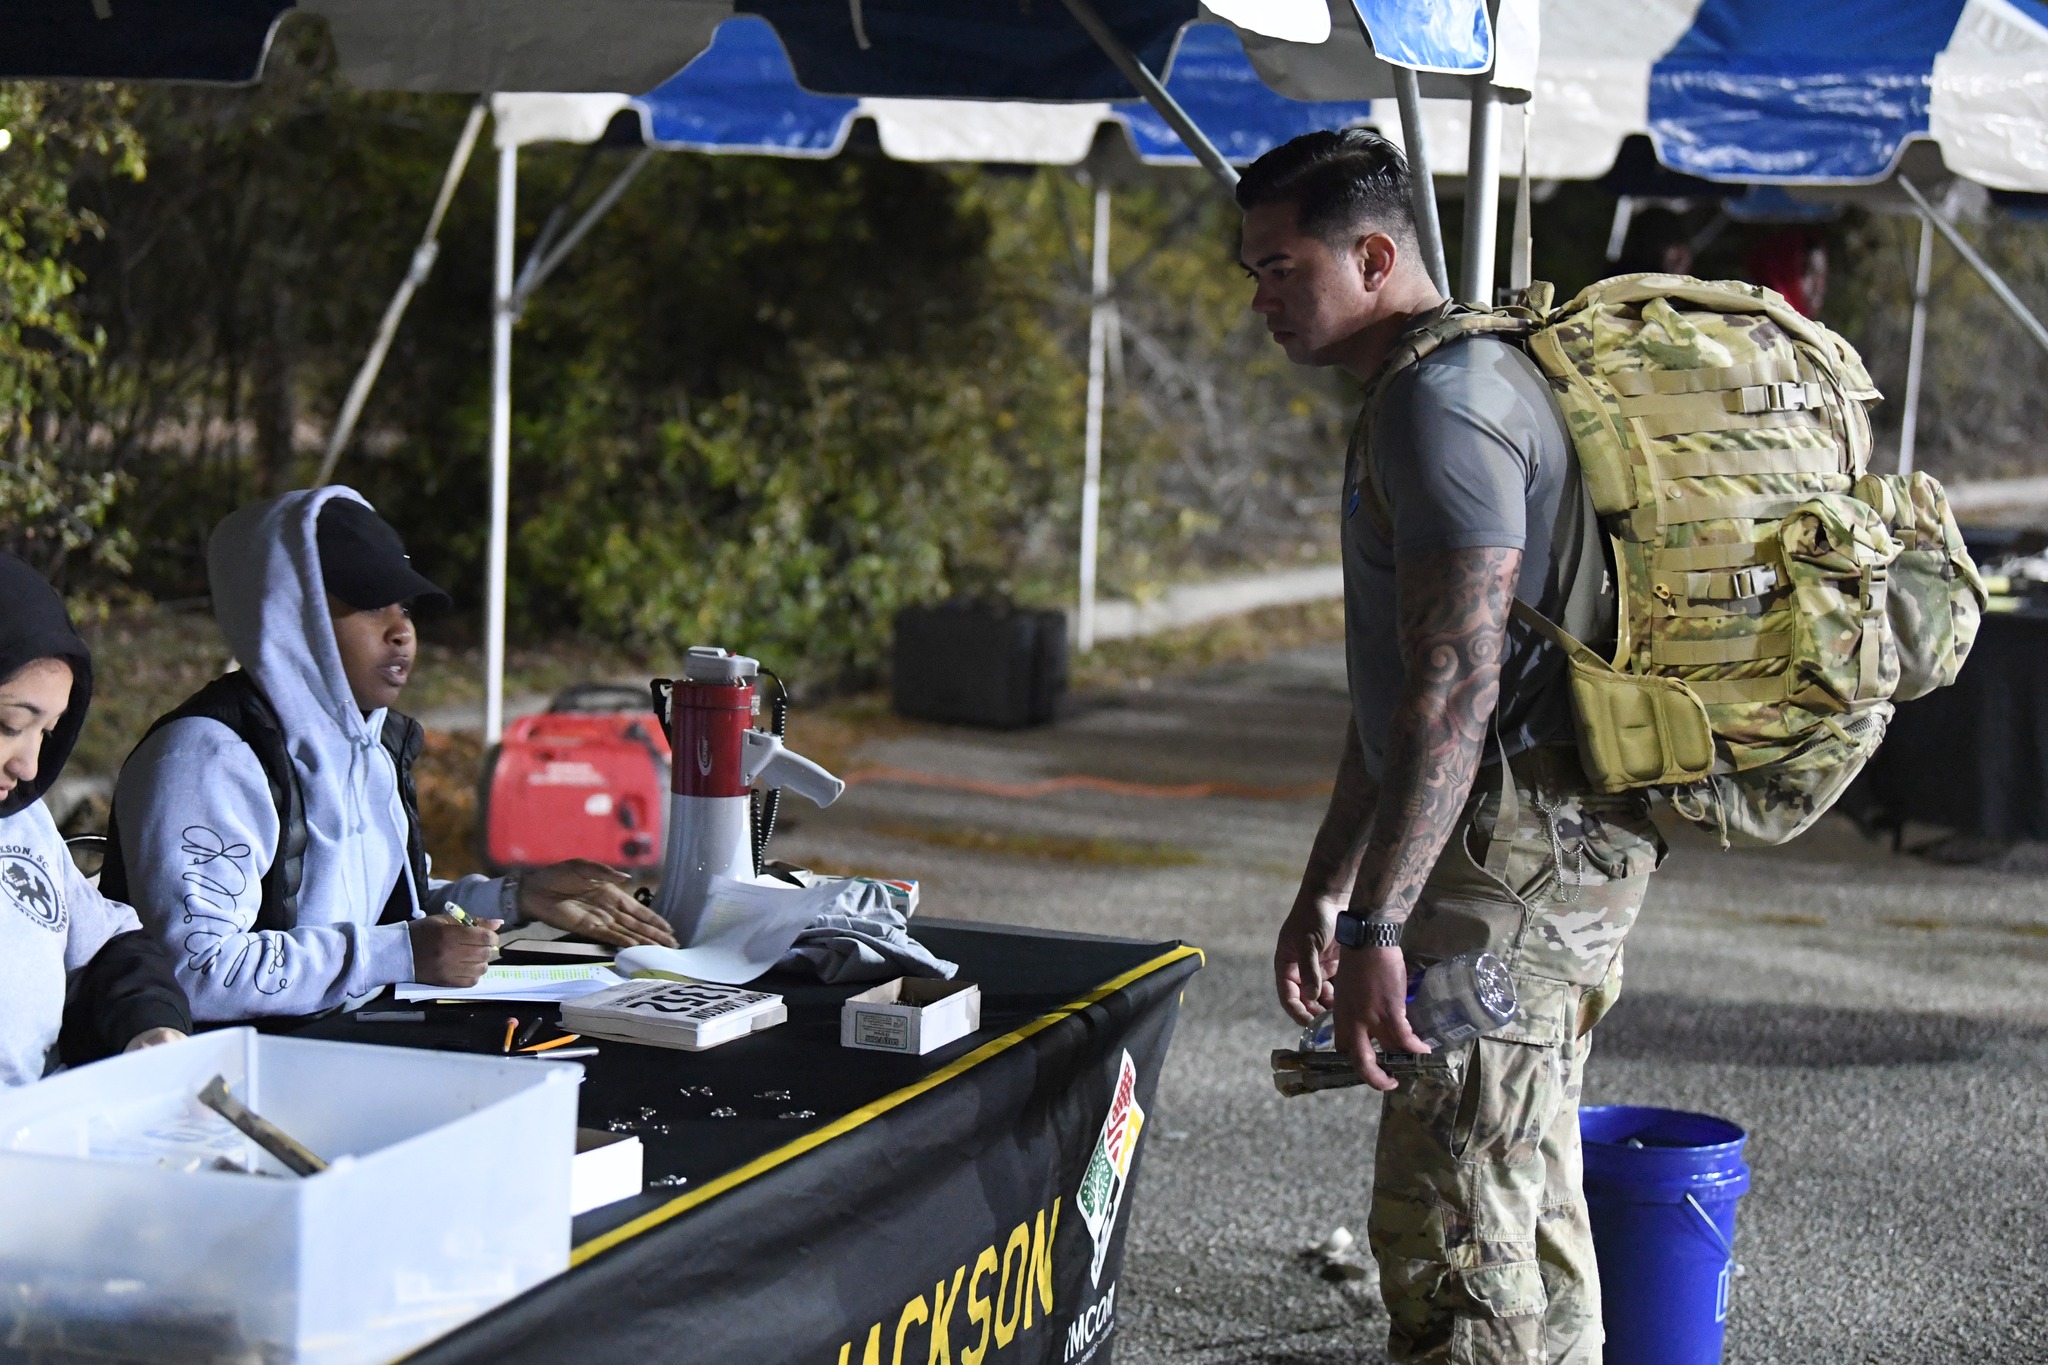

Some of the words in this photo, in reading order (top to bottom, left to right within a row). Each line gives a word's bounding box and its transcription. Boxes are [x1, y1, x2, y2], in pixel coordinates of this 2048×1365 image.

[37, 854, 50, 869] SC
[626, 985, 741, 1013] 1352
[838, 1196, 1061, 1365] CKSON
